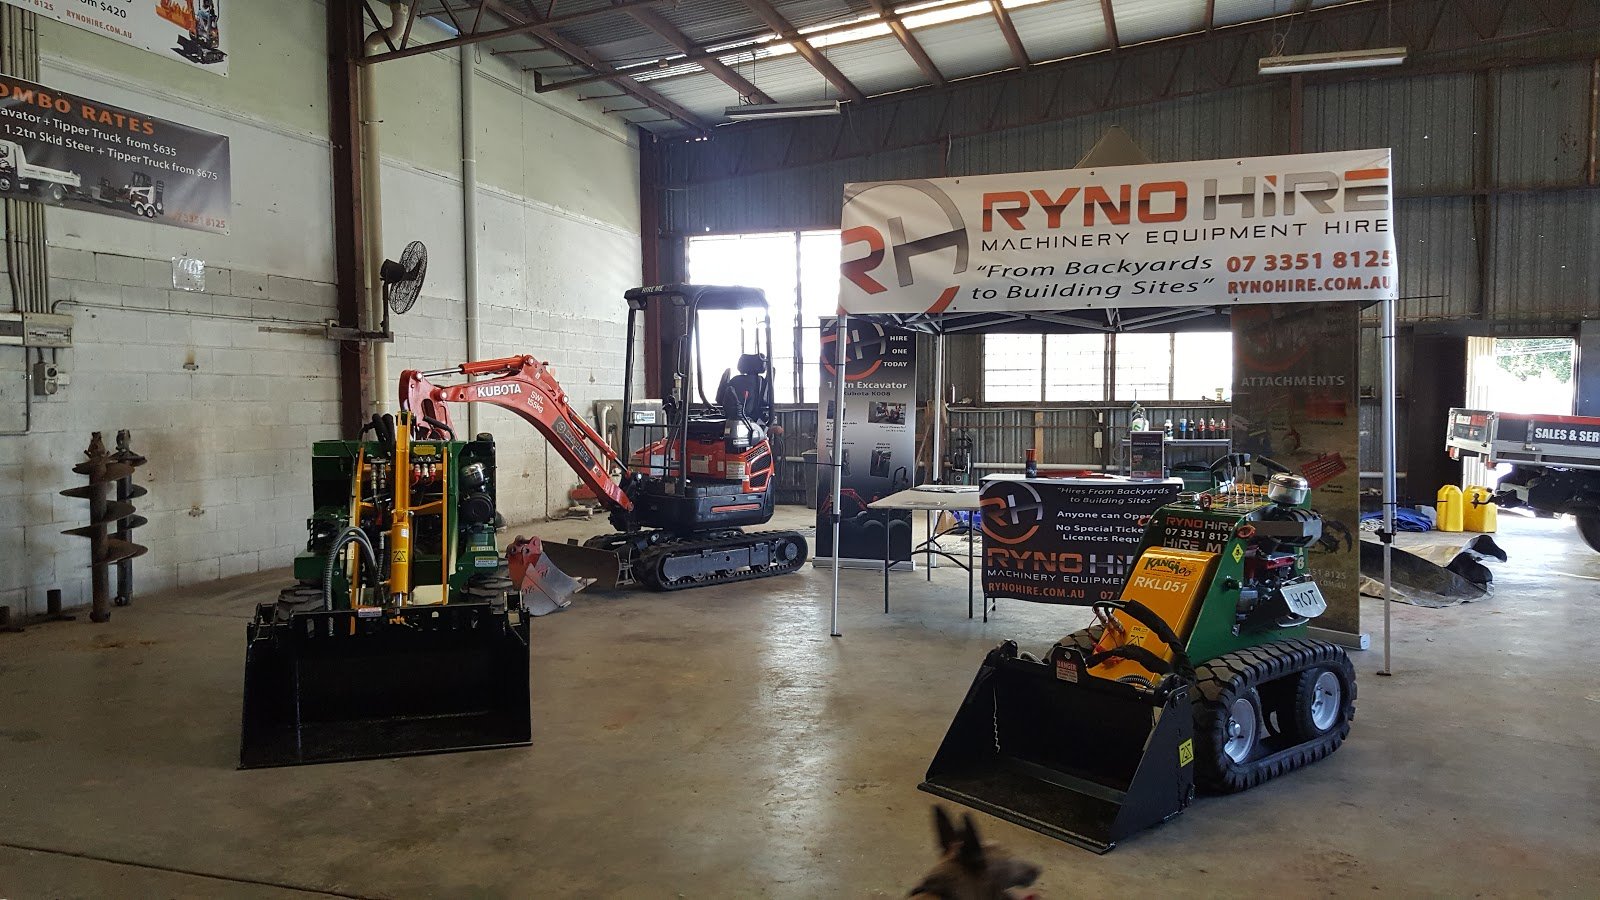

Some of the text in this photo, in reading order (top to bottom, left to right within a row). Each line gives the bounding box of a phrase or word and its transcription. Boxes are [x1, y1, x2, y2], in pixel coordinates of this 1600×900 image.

[100, 1, 127, 18] $420
[66, 9, 132, 39] RYNOHIRE.COM.AU
[81, 105, 154, 135] RATES
[44, 117, 51, 126] +
[53, 118, 89, 136] Tipper
[92, 128, 121, 144] Truck
[126, 137, 151, 151] from
[153, 143, 177, 156] $635
[4, 124, 218, 180] 1.2tn Skid Steer + Tipper Truck from $675
[982, 181, 1188, 232] RYNO
[981, 219, 1389, 252] MACHINERY EQUIPMENT HIRE
[1065, 255, 1213, 276] Backyards
[1226, 256, 1256, 273] 07
[1263, 252, 1322, 271] 3351
[1332, 250, 1393, 268] 8125
[972, 287, 997, 300] to
[1006, 283, 1122, 299] Building
[1227, 276, 1391, 294] RYNOHIRE.COM.AU
[857, 381, 908, 389] Excavator
[1241, 375, 1346, 387] ATTACHMENTS
[477, 383, 522, 398] KUBOTA
[530, 390, 544, 405] SWL
[1534, 427, 1600, 443] SALES & SER
[1117, 487, 1170, 496] Backyards
[1083, 497, 1125, 505] Building
[1057, 511, 1098, 519] Anyone
[1166, 516, 1203, 529] RYNO
[1074, 525, 1113, 533] Special
[1165, 528, 1178, 536] 07
[1180, 529, 1205, 540] 3351
[1062, 534, 1142, 543] Licences Requ
[987, 547, 1083, 573] RYNO
[987, 570, 1057, 581] MACHINERY
[988, 582, 1114, 600] RYNOHIRE.COM.AU 07
[1133, 576, 1188, 594] RKL051
[1290, 589, 1318, 609] HOT
